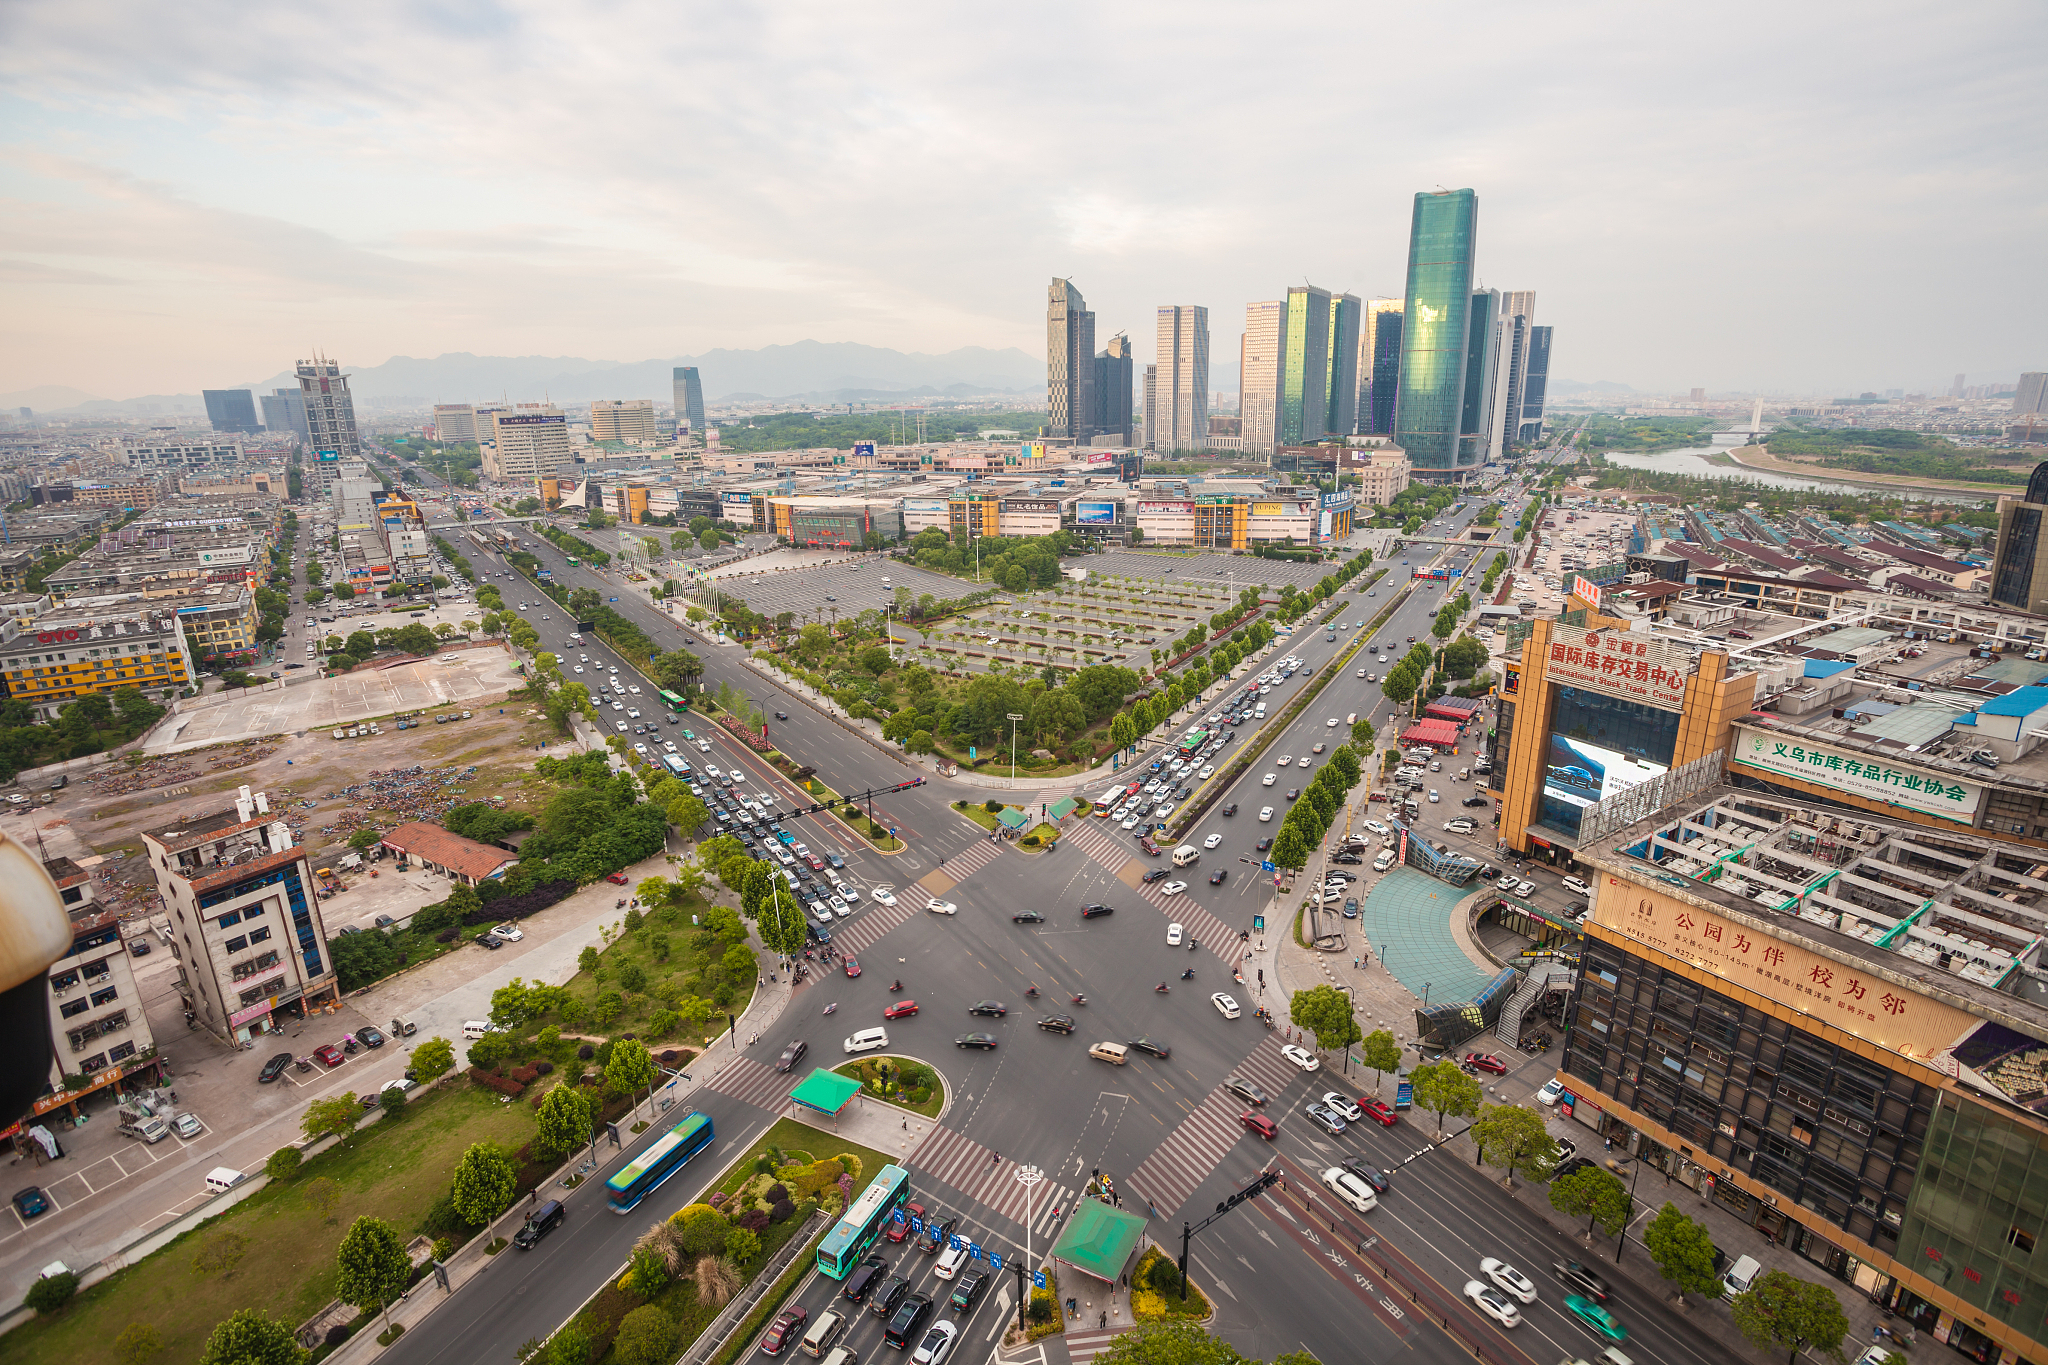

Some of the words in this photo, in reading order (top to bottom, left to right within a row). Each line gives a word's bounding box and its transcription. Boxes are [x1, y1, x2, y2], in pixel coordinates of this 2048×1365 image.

[1254, 504, 1281, 512] XUPING
[217, 573, 244, 582] HOTEL
[37, 629, 79, 643] OYO
[1606, 637, 1648, 657] 金福源
[1550, 643, 1683, 690] 国际库存交易中心
[1549, 665, 1596, 683] International
[1598, 676, 1621, 689] Stock
[1625, 682, 1647, 696] Trade
[1652, 689, 1682, 703] Center
[1771, 742, 1967, 803] 义乌市库存品行业协会
[1647, 935, 1667, 948] 5777
[1674, 947, 1695, 960] 8272
[1698, 956, 1719, 970] 7777
[1675, 912, 1785, 967] 公园为伴
[1807, 964, 1908, 1016] 校为邻
[1300, 1228, 1404, 1320] 公交专用
